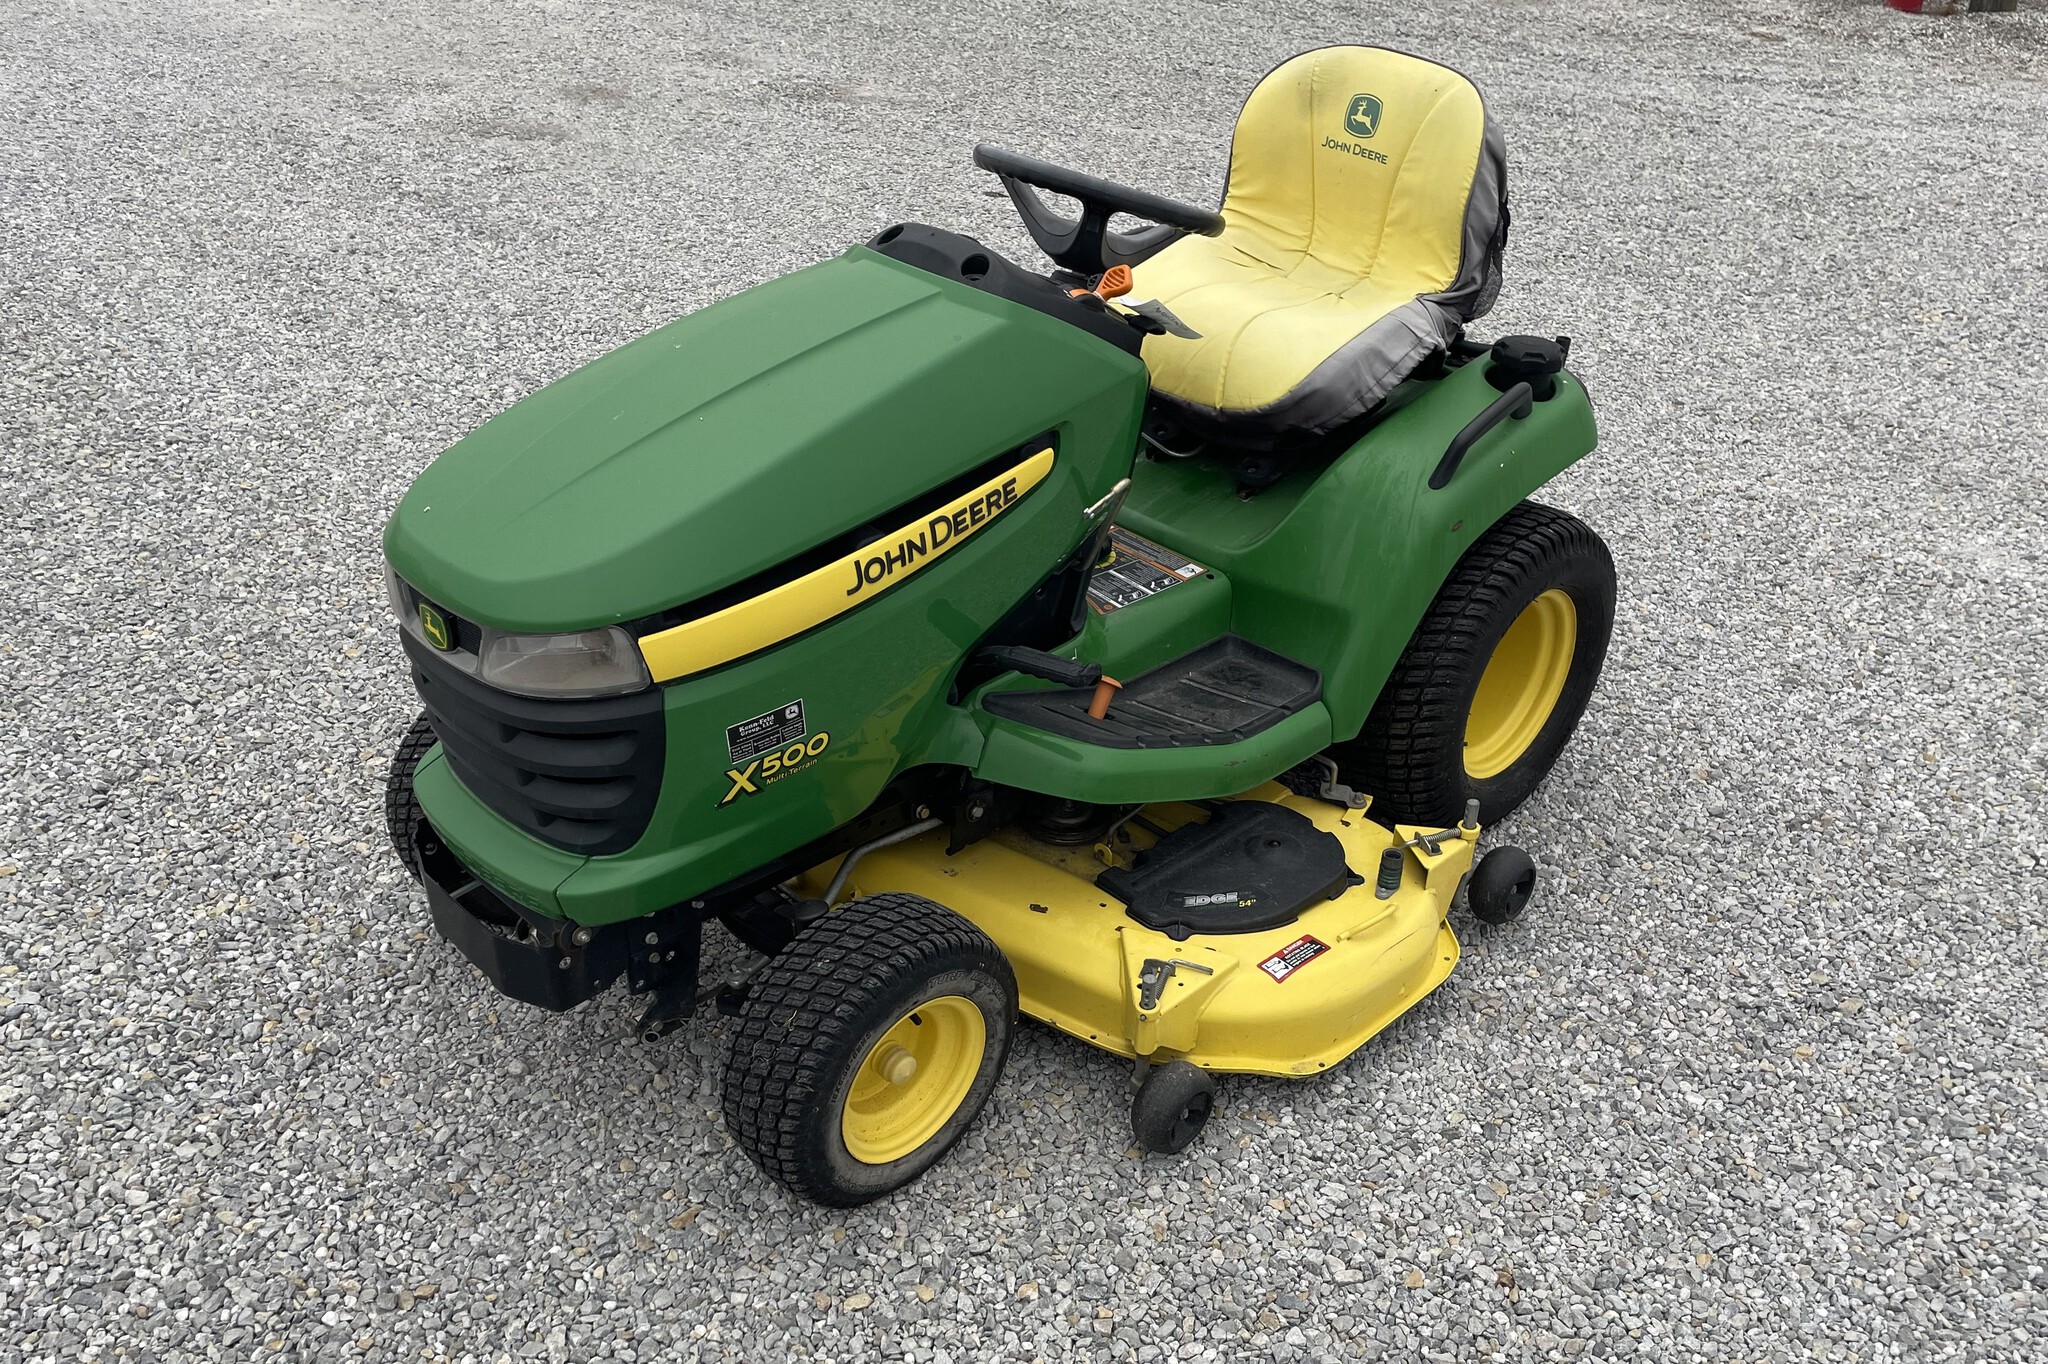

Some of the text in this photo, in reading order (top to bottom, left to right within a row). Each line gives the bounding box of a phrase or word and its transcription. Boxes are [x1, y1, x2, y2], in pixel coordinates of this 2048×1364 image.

[1321, 136, 1388, 165] JOHN DEERE
[846, 476, 1018, 596] JOHN DEERE
[739, 714, 775, 732] Kenn-Feld
[721, 732, 829, 804] X500
[766, 758, 818, 785] Multi-Terrain
[1183, 892, 1239, 908] EDGE
[927, 969, 962, 989] TURF
